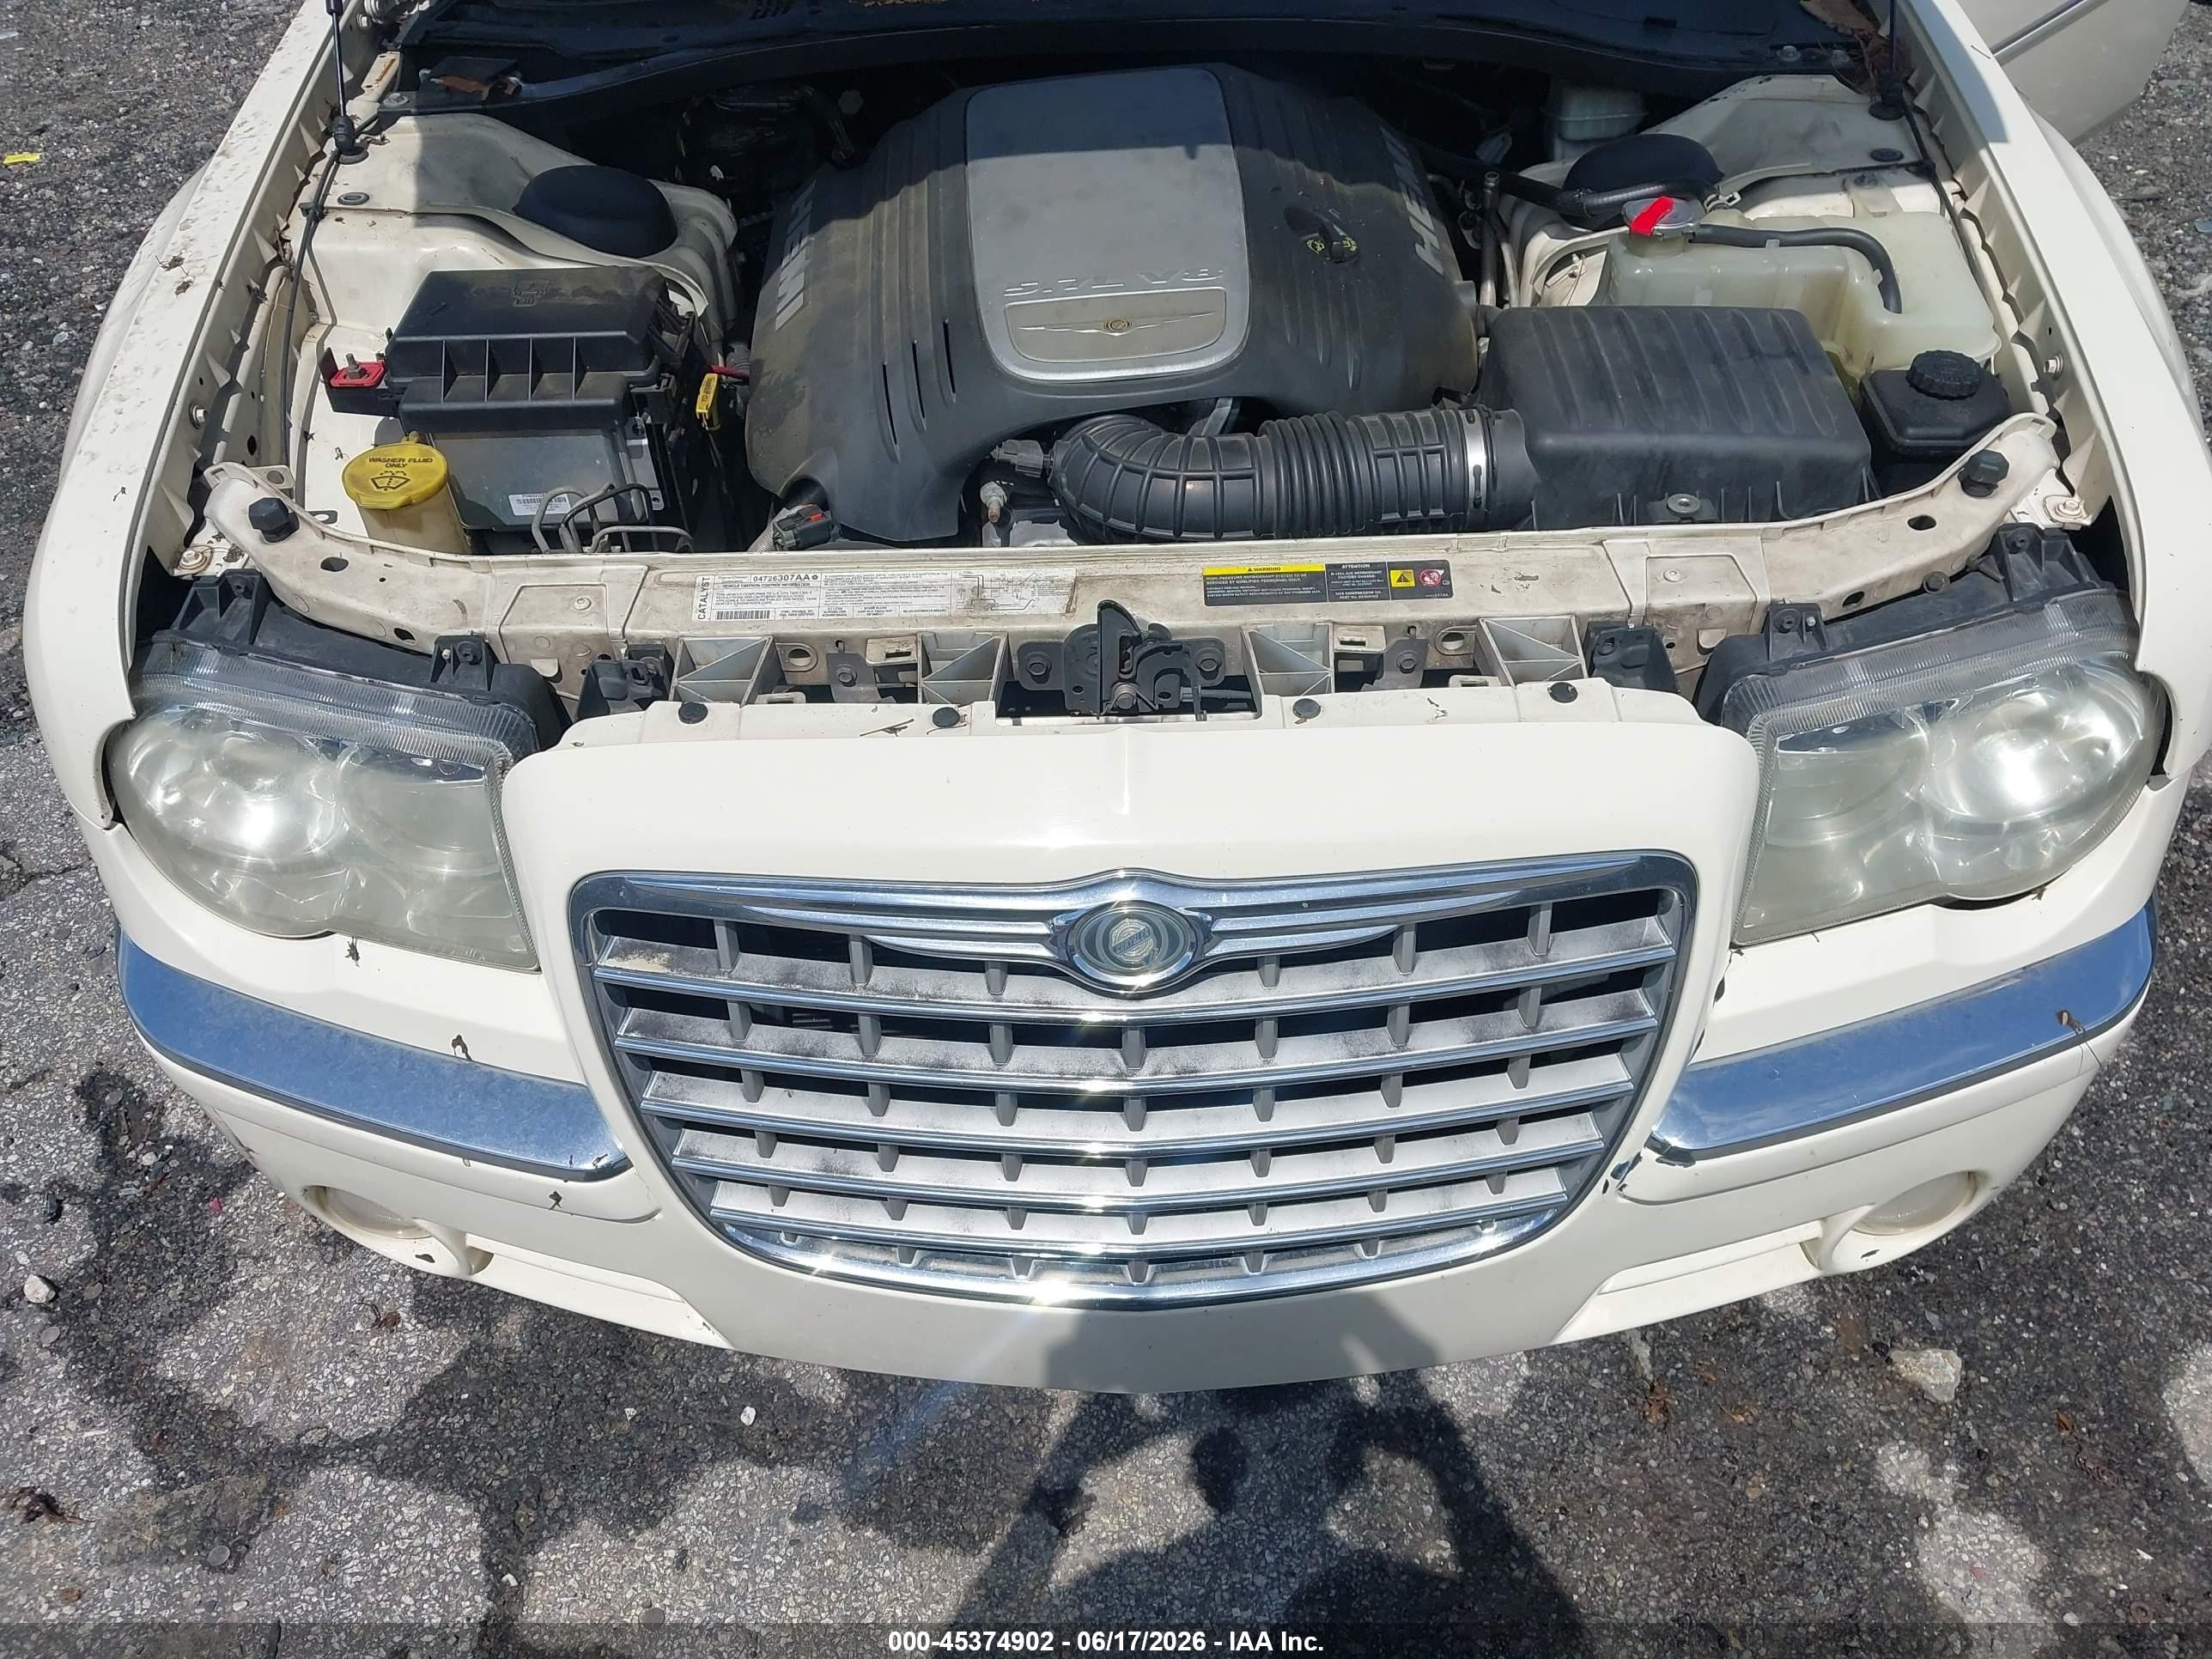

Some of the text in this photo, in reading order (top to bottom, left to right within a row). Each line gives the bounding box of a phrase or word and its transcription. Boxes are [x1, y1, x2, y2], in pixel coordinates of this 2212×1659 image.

[1381, 126, 1443, 276] HEMI
[775, 179, 816, 331] HEMI
[1135, 268, 1224, 284] V8
[698, 577, 710, 620] CATALYST
